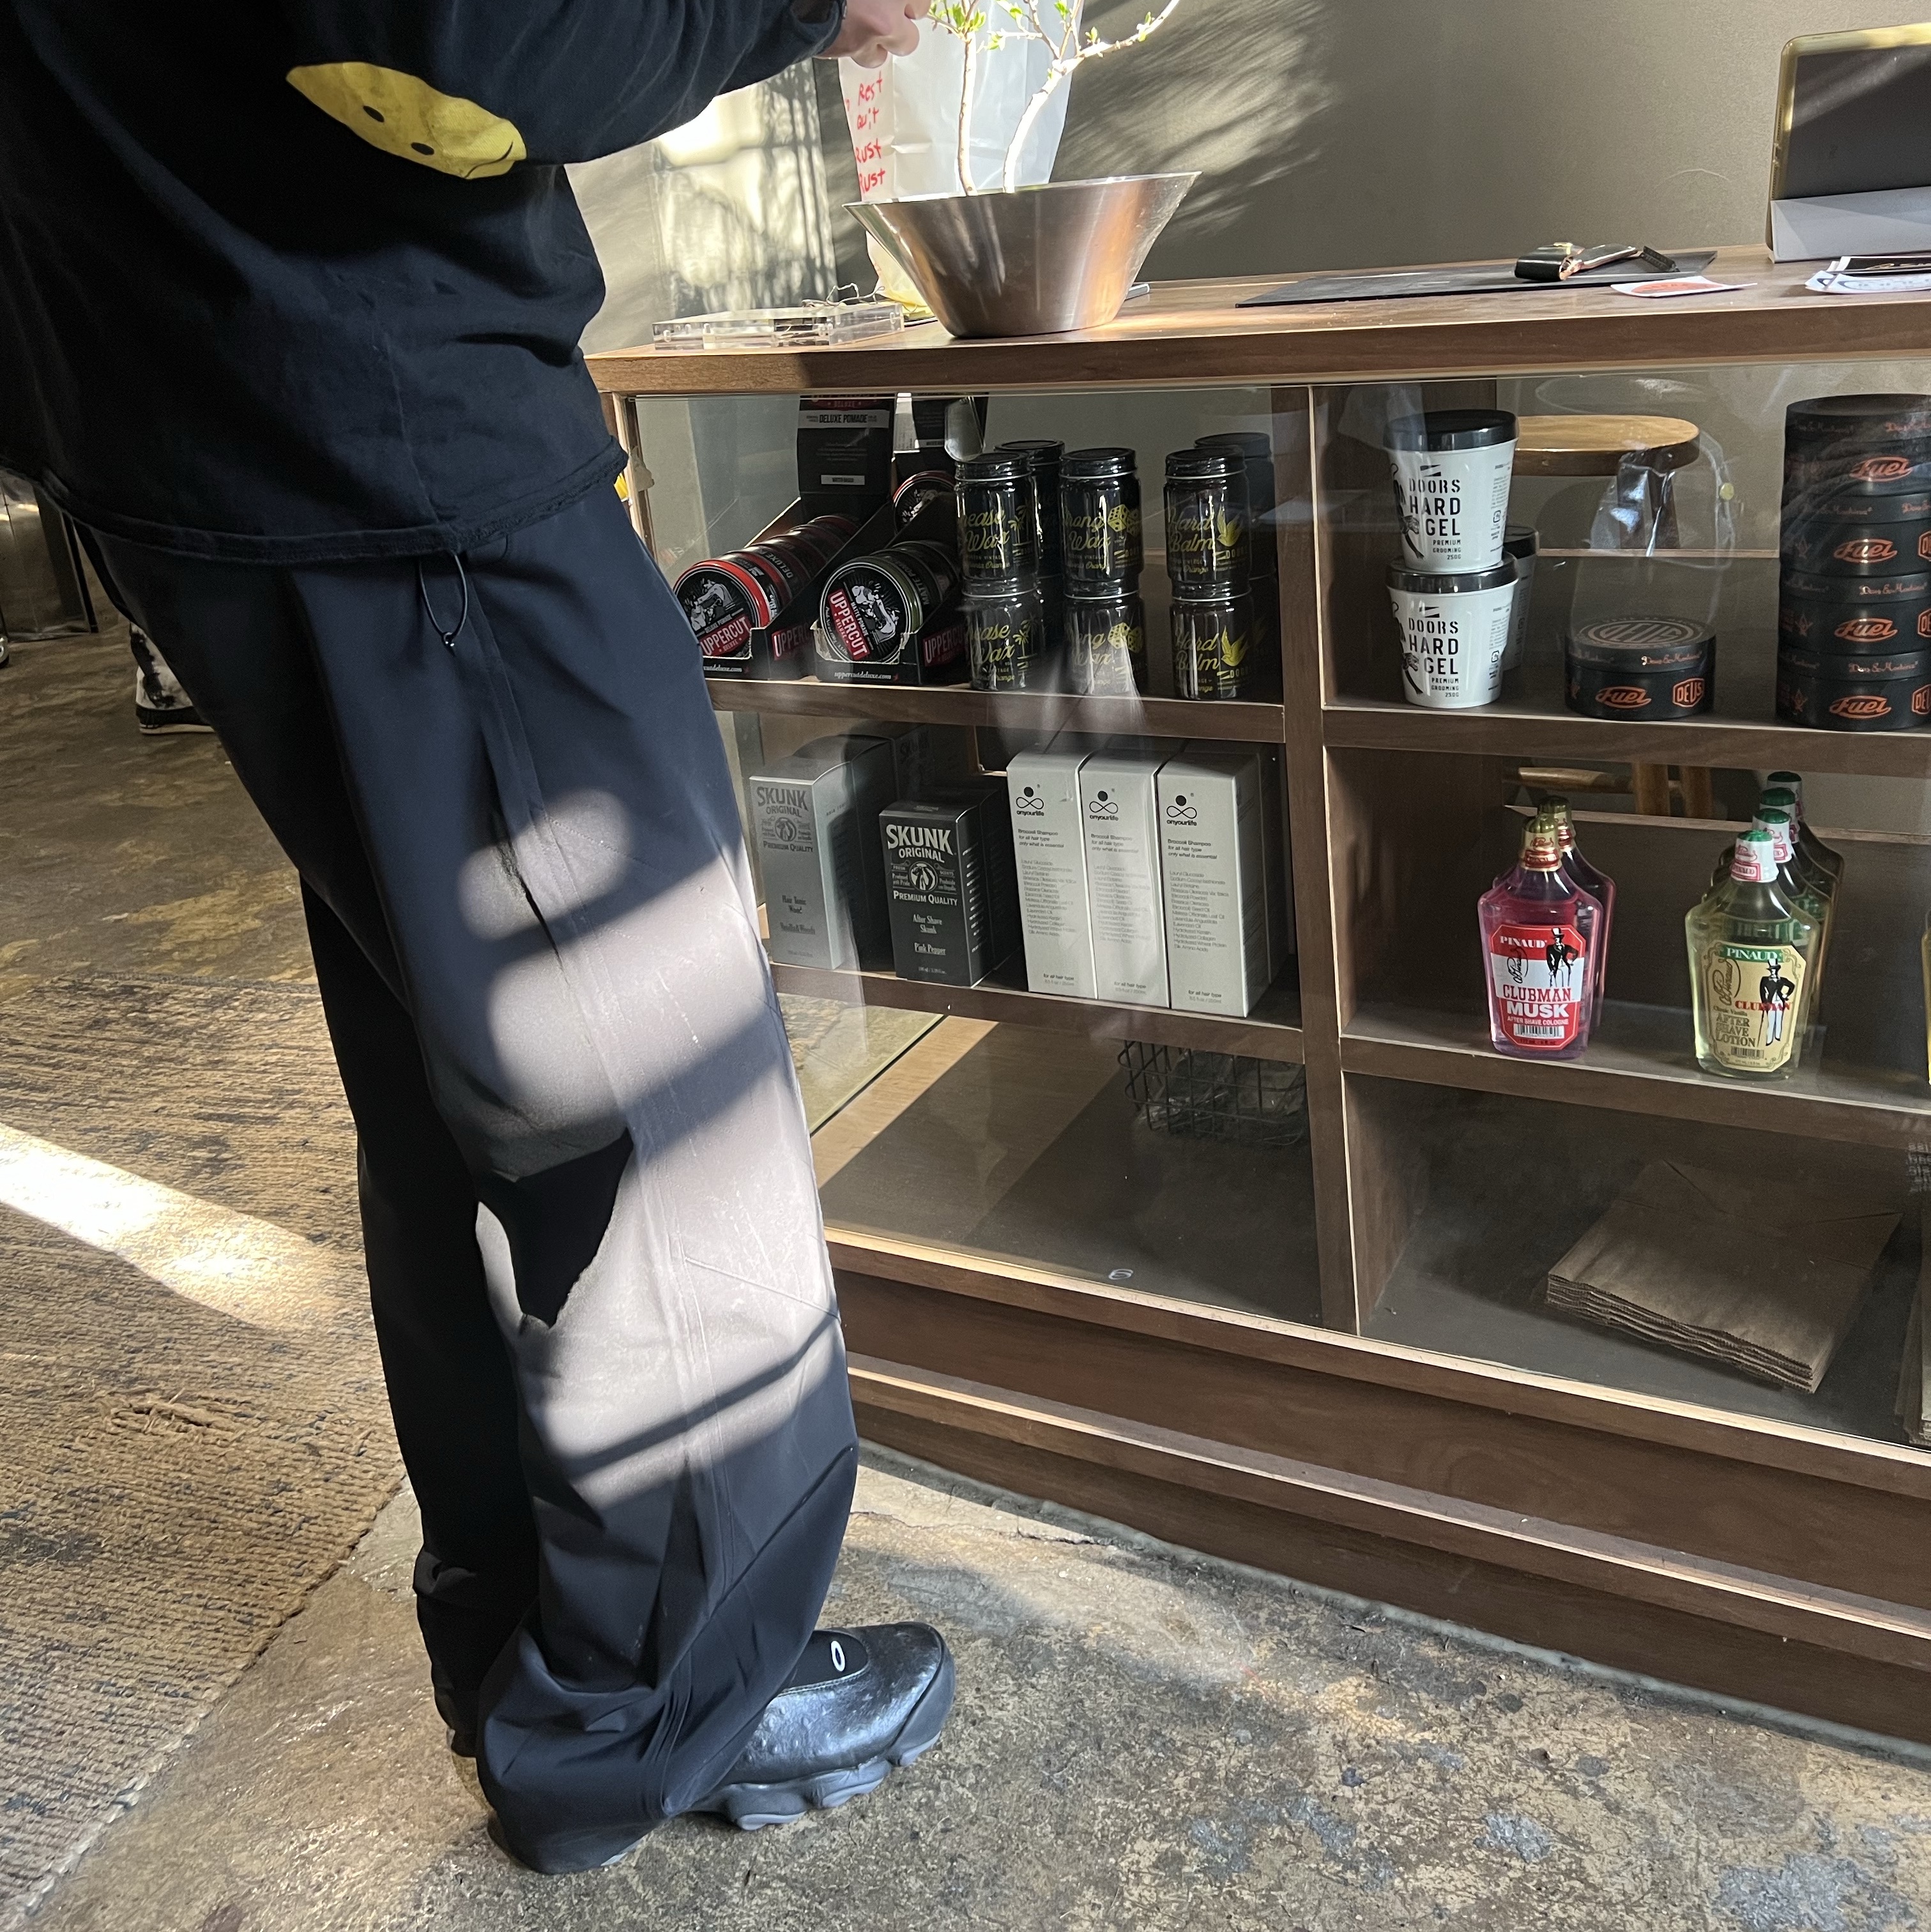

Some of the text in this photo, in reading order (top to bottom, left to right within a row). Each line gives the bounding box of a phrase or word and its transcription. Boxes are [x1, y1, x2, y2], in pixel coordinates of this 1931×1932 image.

[819, 415, 842, 423] DELUXE
[843, 415, 868, 423] POMADE
[1409, 478, 1460, 493] DOORS
[1410, 495, 1461, 515] HARD
[1168, 506, 1214, 531] Hard
[1426, 519, 1460, 536] GEL
[1170, 531, 1215, 552] Balm
[1833, 539, 1898, 563] Fuel
[830, 591, 867, 657] UPPERCUT
[1408, 617, 1458, 634] DOORS
[1835, 618, 1898, 642] Fuel
[701, 616, 751, 656] UPPERCUT
[1409, 634, 1458, 655] HARD
[703, 664, 742, 673] cutdeluxe.com
[1176, 650, 1221, 671] Blm
[1424, 657, 1458, 674] GEL
[834, 671, 891, 680] uppercutdeluxe.com
[1595, 688, 1652, 704] Fuel
[1677, 681, 1703, 703] DEUS
[1829, 696, 1892, 719] Fuel
[757, 786, 809, 811] SKUNK
[766, 805, 802, 818] ORIGINAL
[763, 840, 813, 852] PREMIUM QUALITY
[886, 824, 954, 855] SKUNK
[899, 848, 945, 863] ORIGINAL
[893, 890, 958, 906] PREMIUM QUALITY
[913, 914, 942, 925] After Shave
[915, 943, 946, 955] Pink Pepper
[1500, 936, 1546, 948] PINAUD
[1727, 947, 1778, 961] PINAUD
[1503, 984, 1571, 1003] CLUBMAN
[1507, 1001, 1569, 1018] MUSK
[1735, 1000, 1792, 1011] CLUBMAN
[1716, 1012, 1750, 1028] AFTER
[1716, 1024, 1749, 1037] SHAVE
[1716, 1033, 1755, 1047] LOTION
